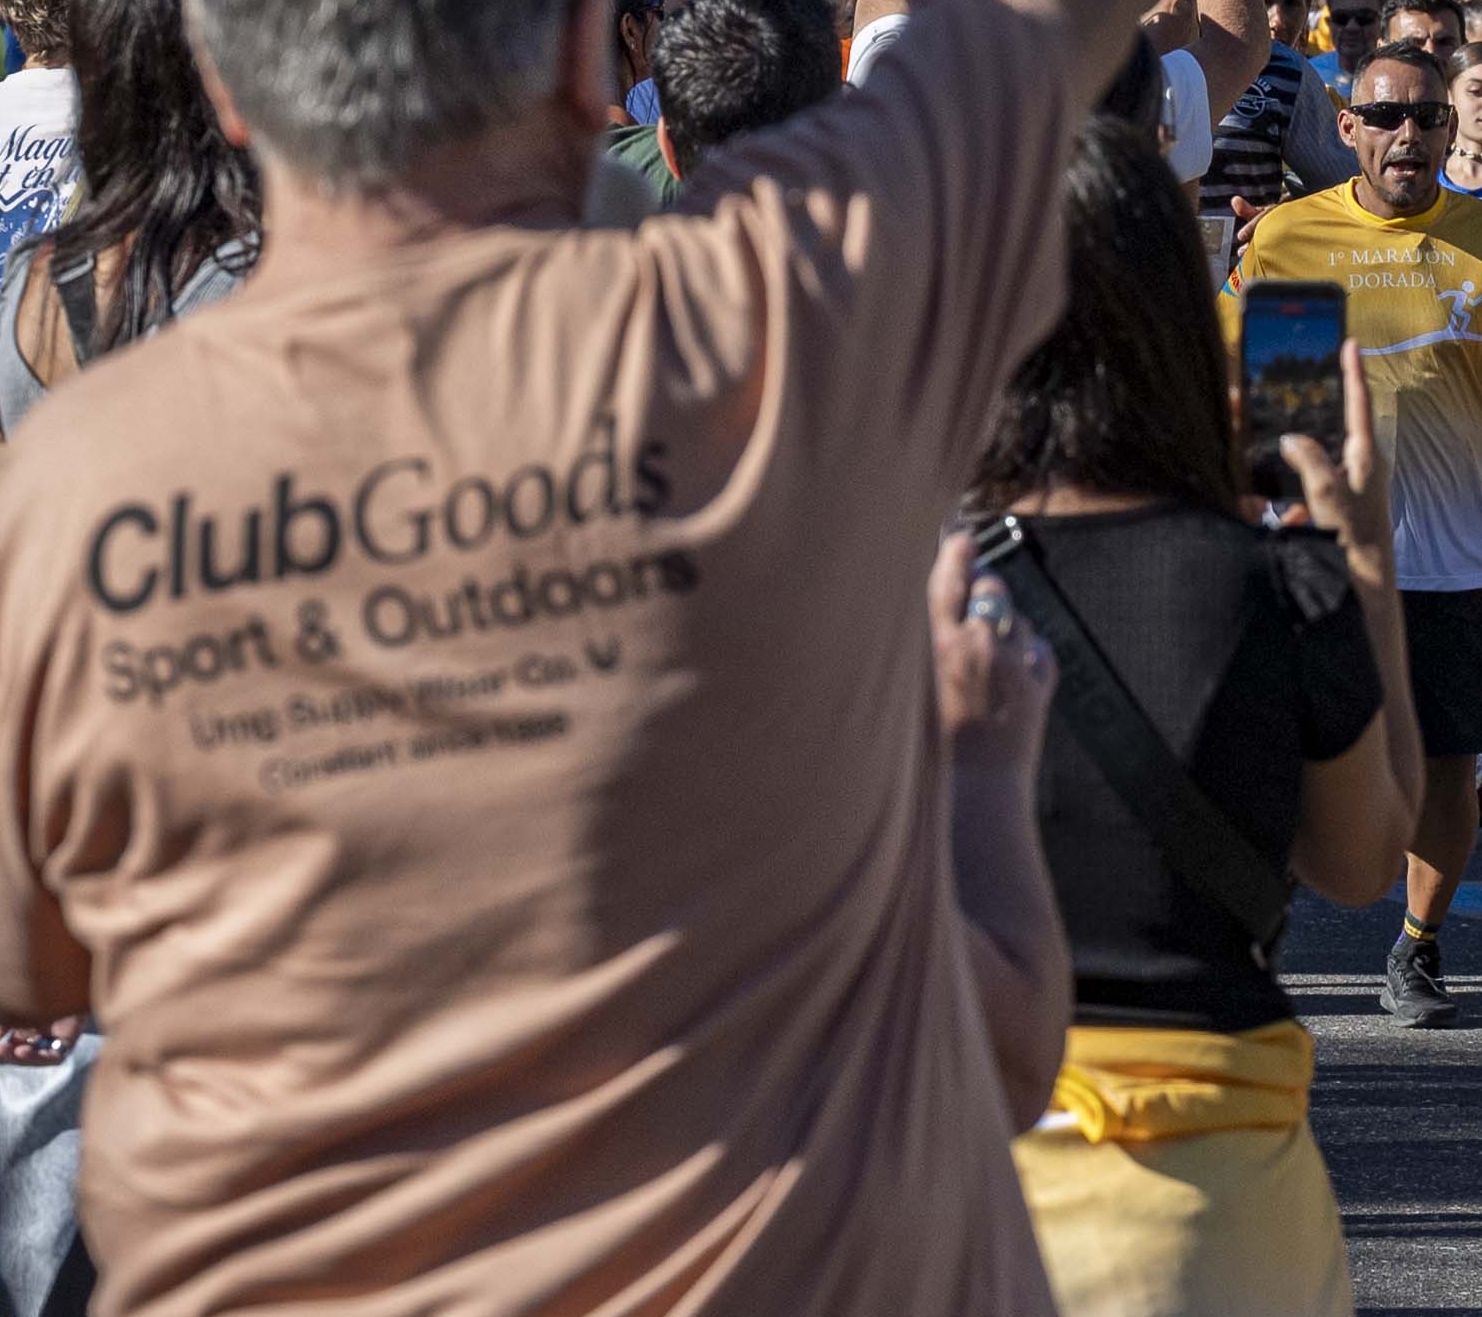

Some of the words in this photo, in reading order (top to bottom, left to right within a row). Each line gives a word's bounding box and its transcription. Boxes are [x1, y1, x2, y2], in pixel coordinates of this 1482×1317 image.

[1328, 250, 1346, 268] 1°
[1349, 272, 1438, 290] DORADA
[102, 604, 277, 707] Sport
